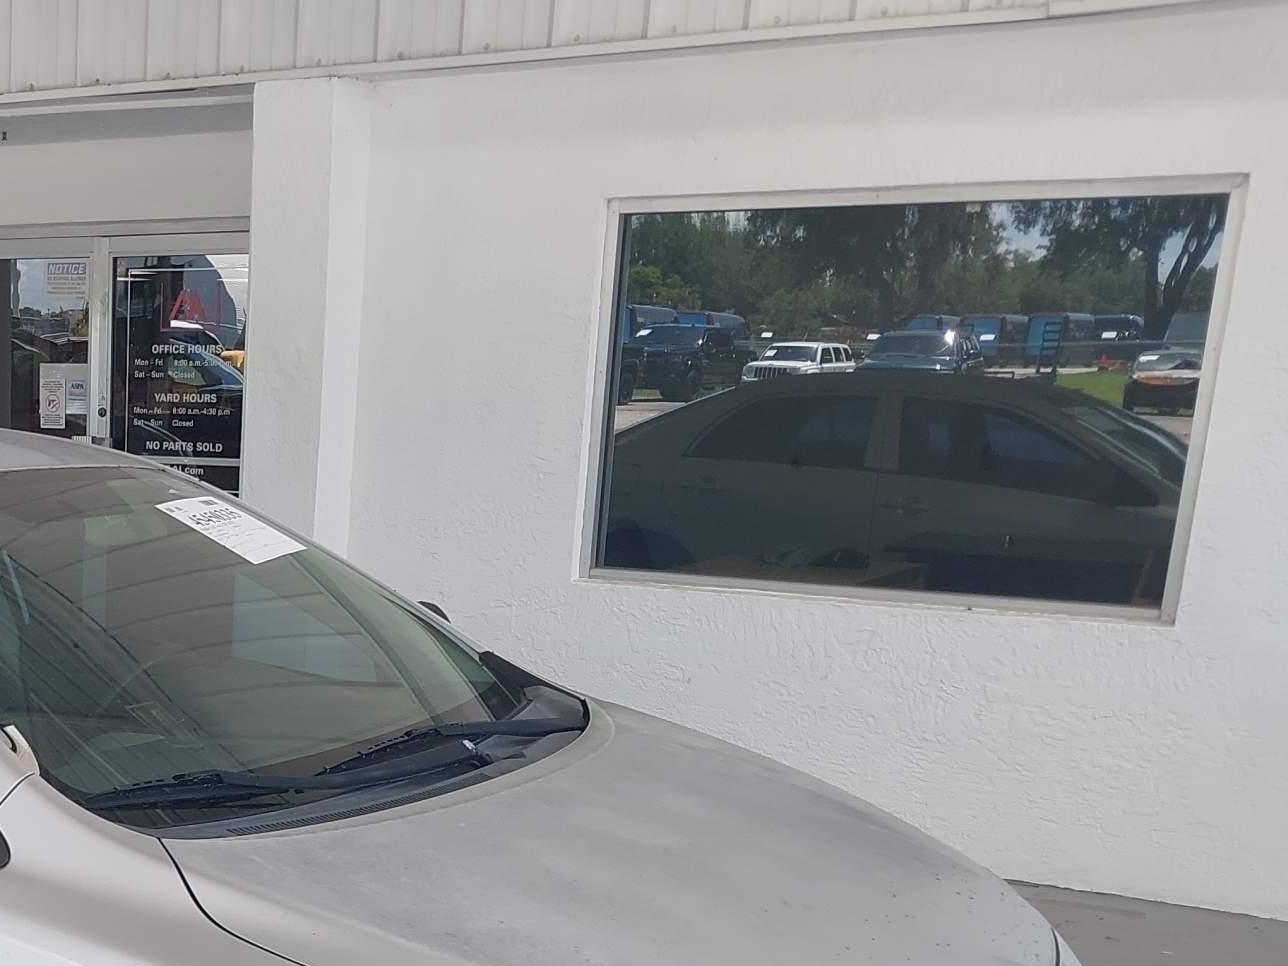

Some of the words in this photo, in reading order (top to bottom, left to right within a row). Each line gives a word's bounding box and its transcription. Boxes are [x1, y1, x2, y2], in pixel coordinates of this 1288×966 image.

[48, 263, 86, 274] NOTICE
[152, 344, 185, 354] OFFICE
[187, 344, 223, 354] HOURS
[134, 370, 145, 378] Sat
[152, 370, 164, 378] Sun
[154, 393, 180, 403] YARD
[183, 393, 217, 403] HOURS
[133, 406, 148, 414] Mon
[172, 407, 187, 415] 8:00
[133, 418, 144, 426] Sat
[151, 418, 163, 426] Sun
[172, 419, 194, 427] Closed
[146, 440, 160, 450] NO
[162, 441, 194, 451] PARTS
[196, 442, 223, 453] SOLD
